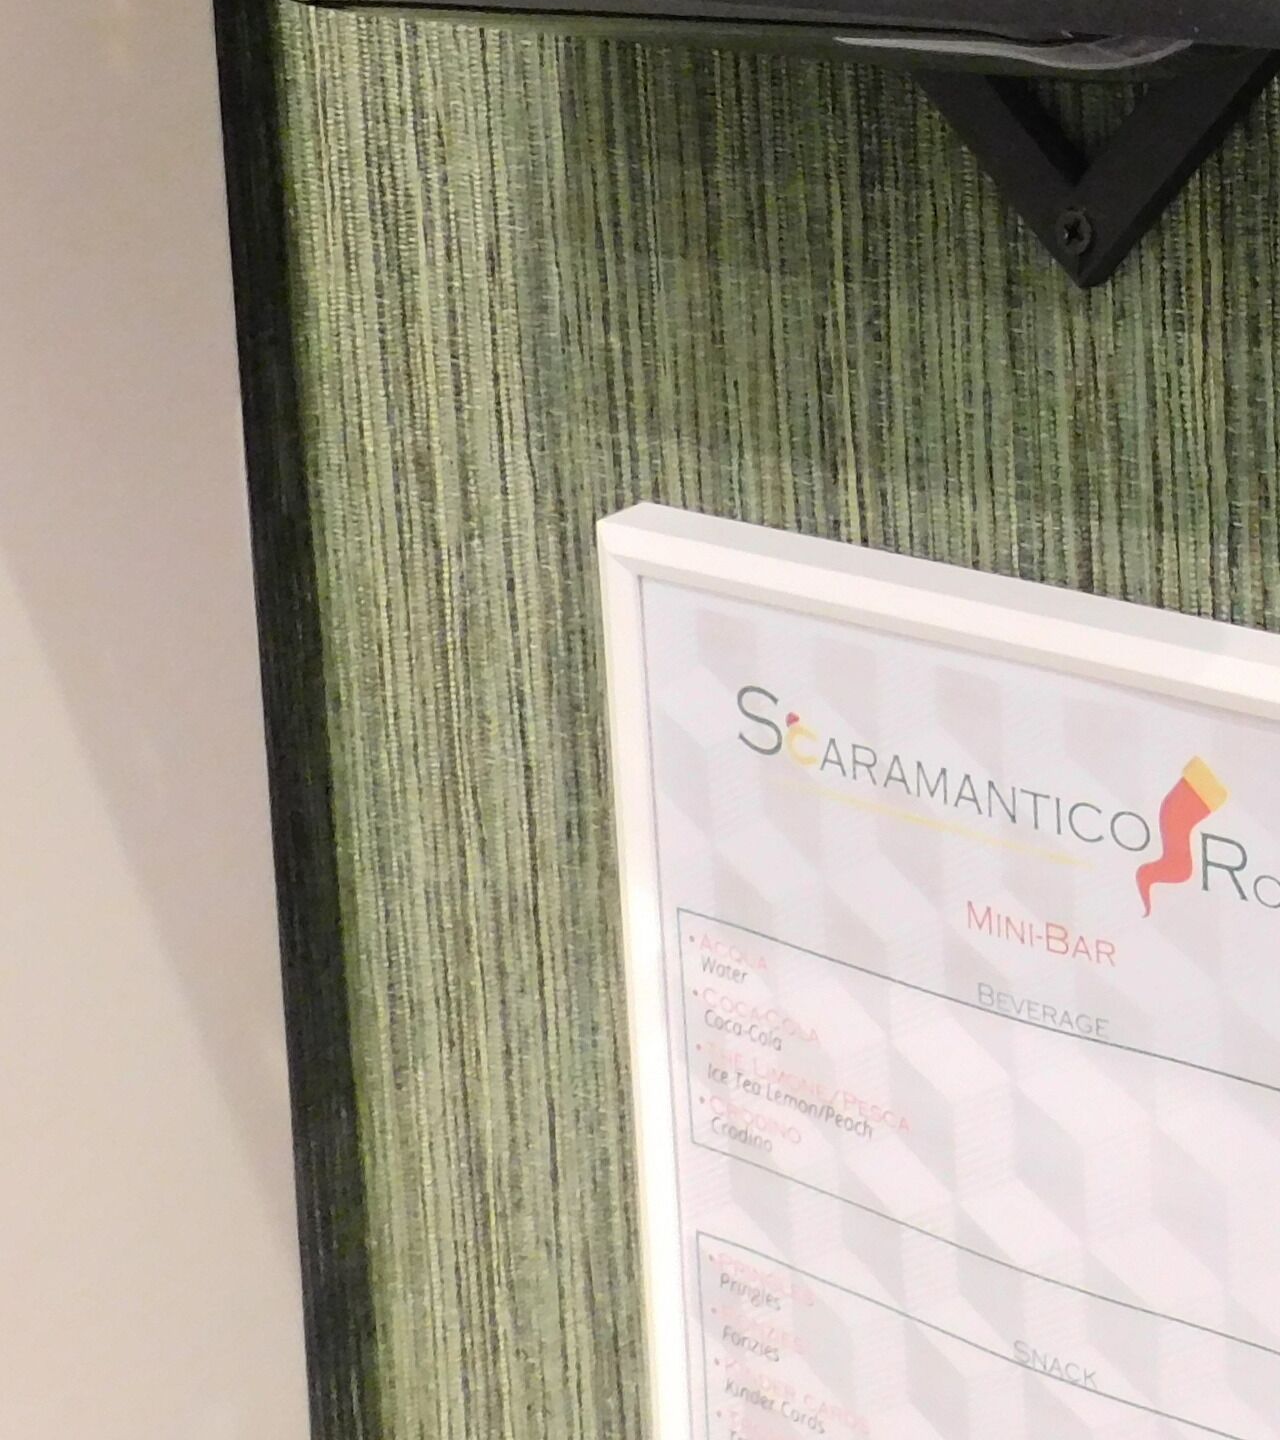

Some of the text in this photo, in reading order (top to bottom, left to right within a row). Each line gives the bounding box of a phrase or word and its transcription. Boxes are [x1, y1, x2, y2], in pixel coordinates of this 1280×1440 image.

[966, 899, 1117, 968] MINI-BAR
[701, 955, 749, 985] Water
[704, 1008, 783, 1052] Coca-Cola
[976, 981, 1110, 1041] BEVERAGE
[707, 1063, 874, 1139] Ice Tea Lemon/Peach
[711, 1115, 773, 1154] Crodino
[1013, 1340, 1098, 1390] SNACK
